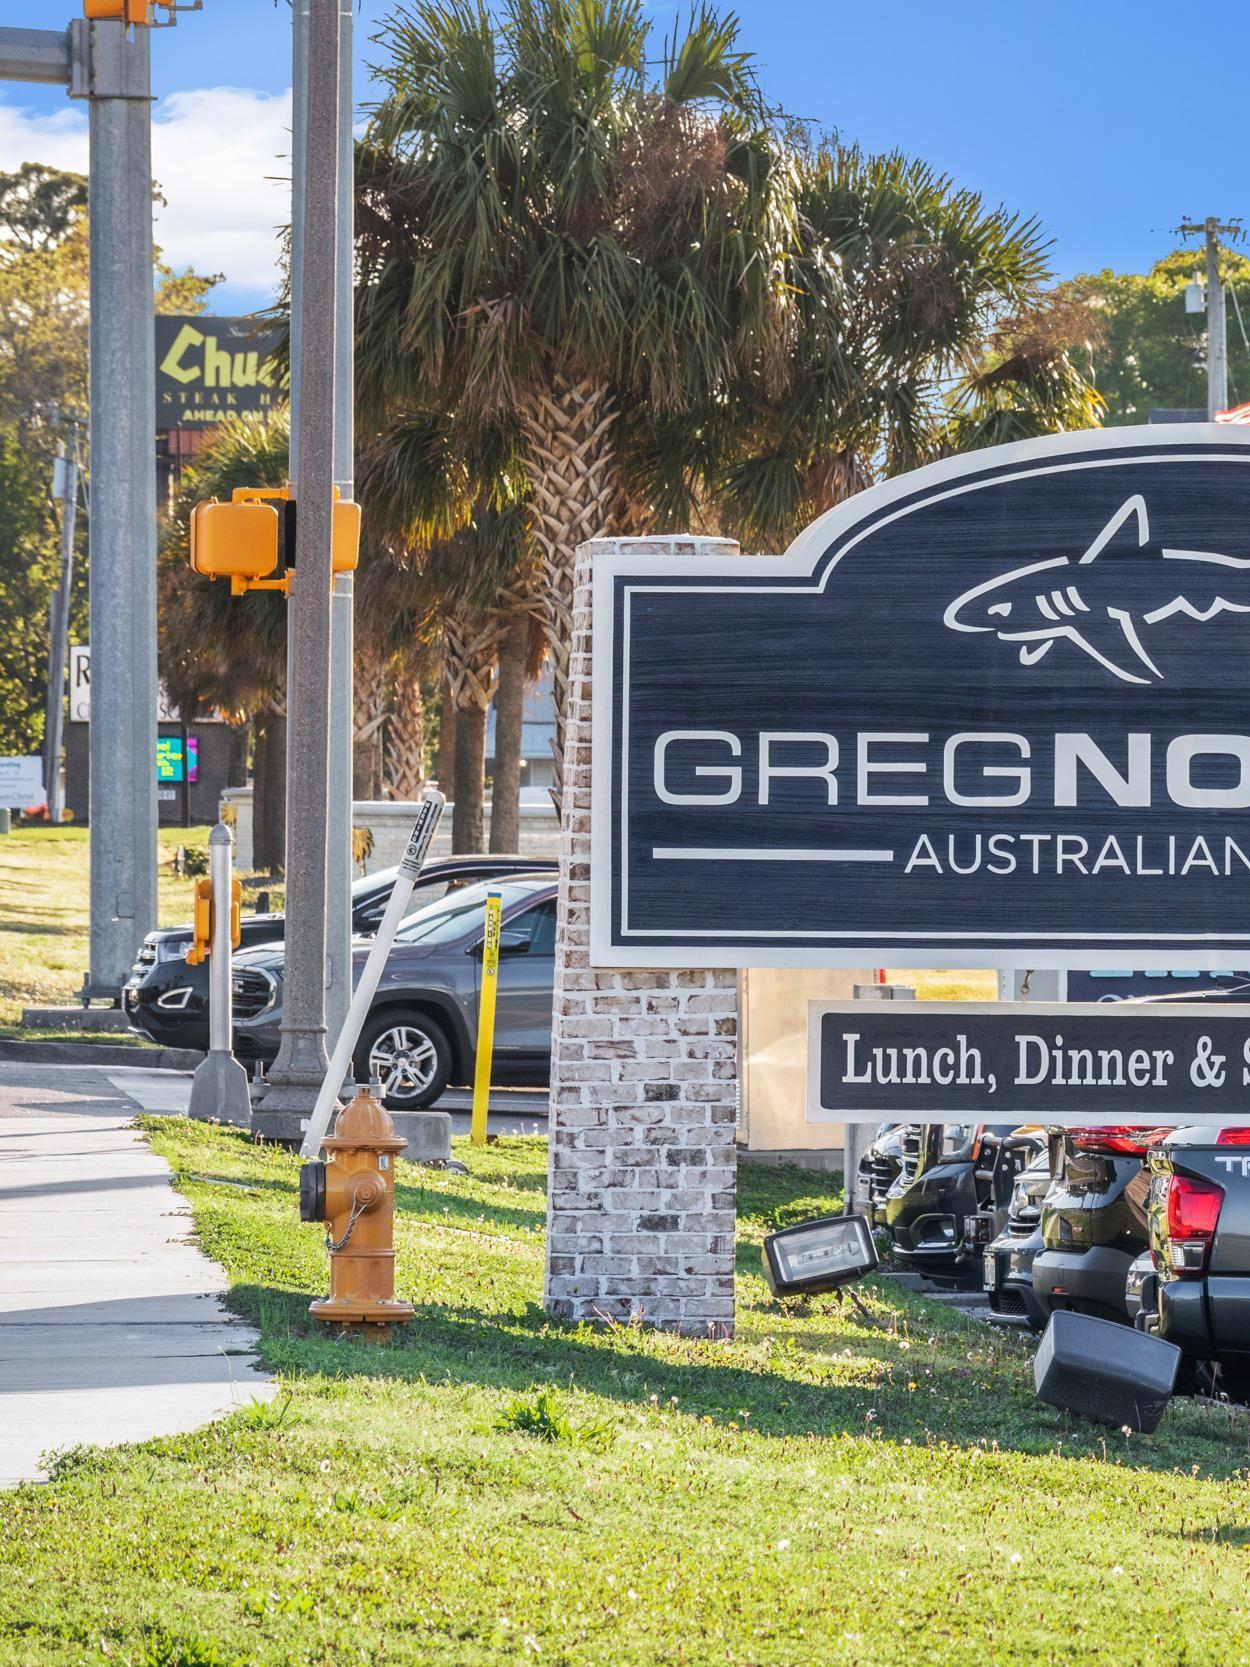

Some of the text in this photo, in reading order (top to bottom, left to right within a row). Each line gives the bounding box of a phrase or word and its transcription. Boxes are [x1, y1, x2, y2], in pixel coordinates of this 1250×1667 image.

[162, 391, 237, 405] STEAK
[841, 1033, 997, 1094] Lunch,
[1014, 1034, 1175, 1087] Dinner
[1189, 1035, 1226, 1088] &
